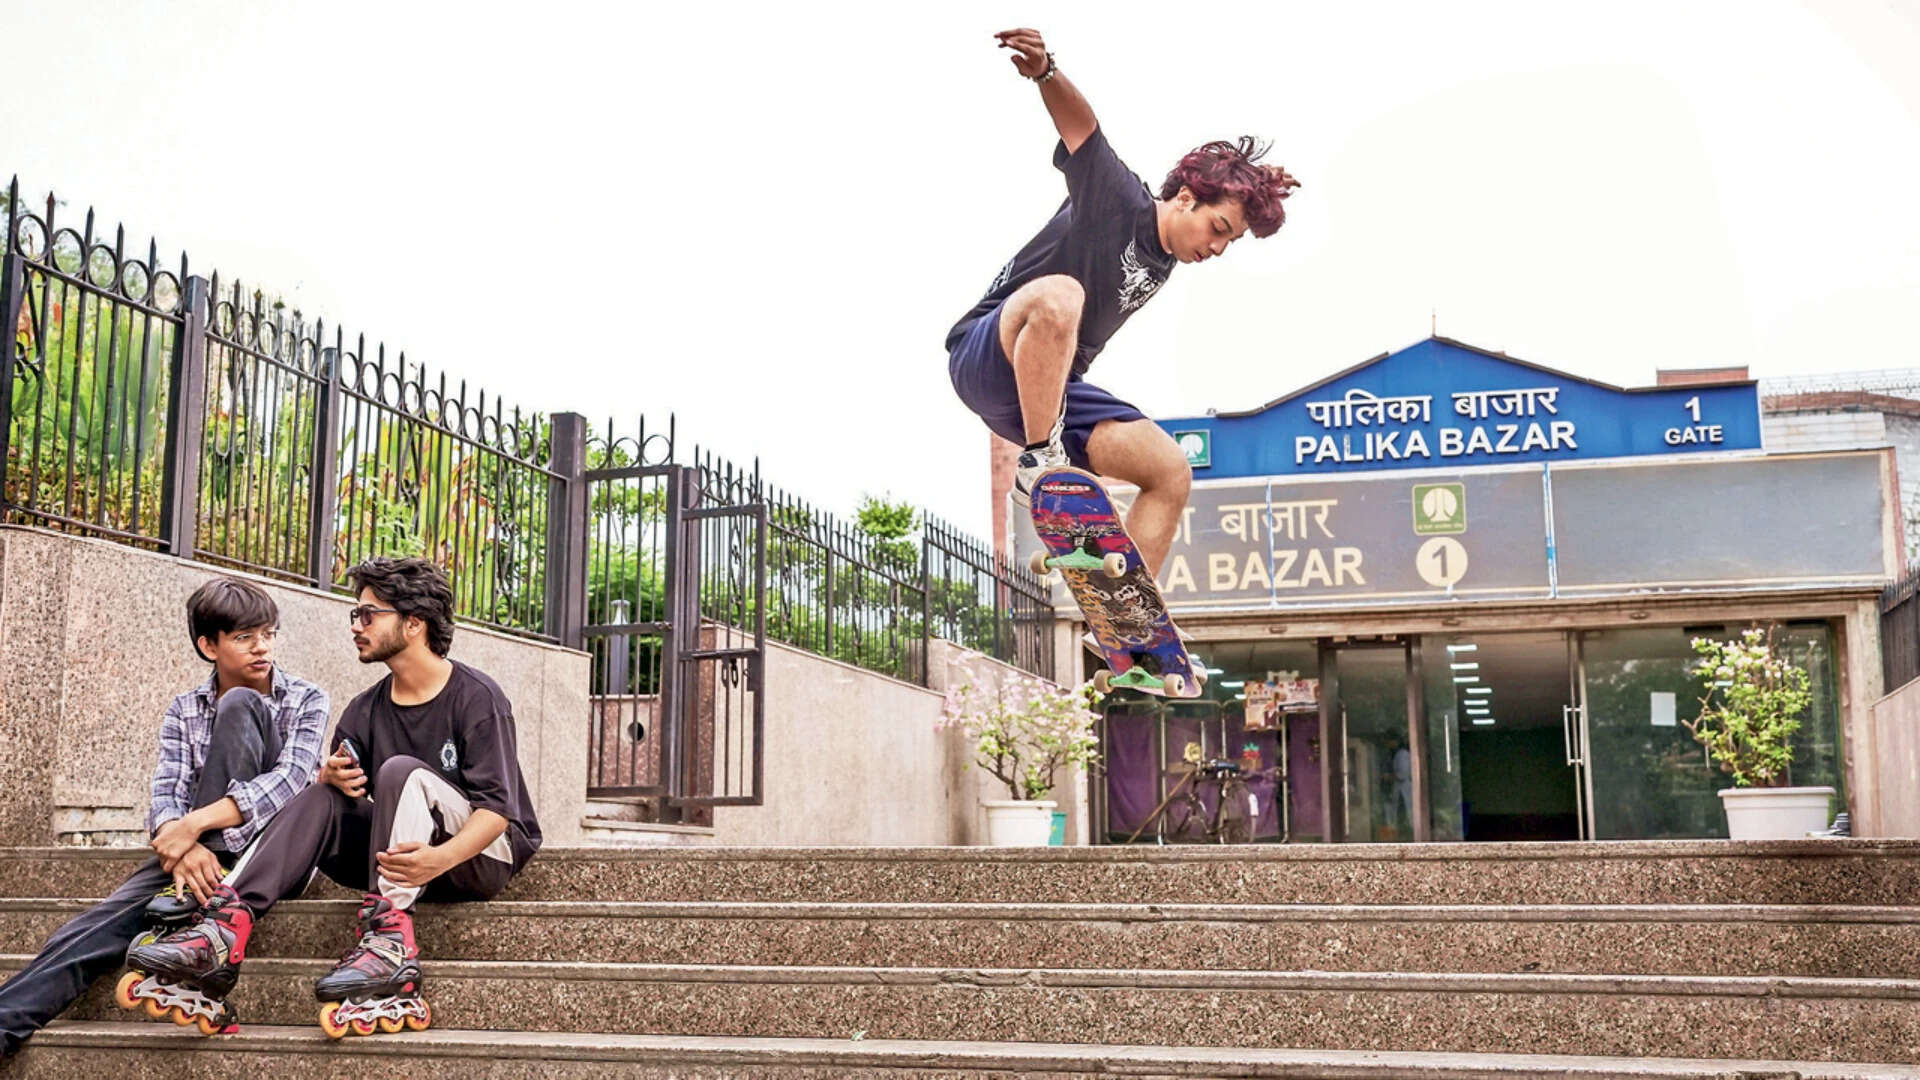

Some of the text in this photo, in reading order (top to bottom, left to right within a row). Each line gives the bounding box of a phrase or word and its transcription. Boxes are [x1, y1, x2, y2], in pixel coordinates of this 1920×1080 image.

[1306, 387, 1559, 428] पालिका बाजार
[1685, 396, 1701, 422] 1
[1295, 421, 1578, 464] PALIKA BAZAR
[1664, 425, 1724, 445] GATE
[1218, 499, 1338, 542] बाजार
[1208, 547, 1367, 592] BAZAR
[1432, 545, 1448, 578] 1
